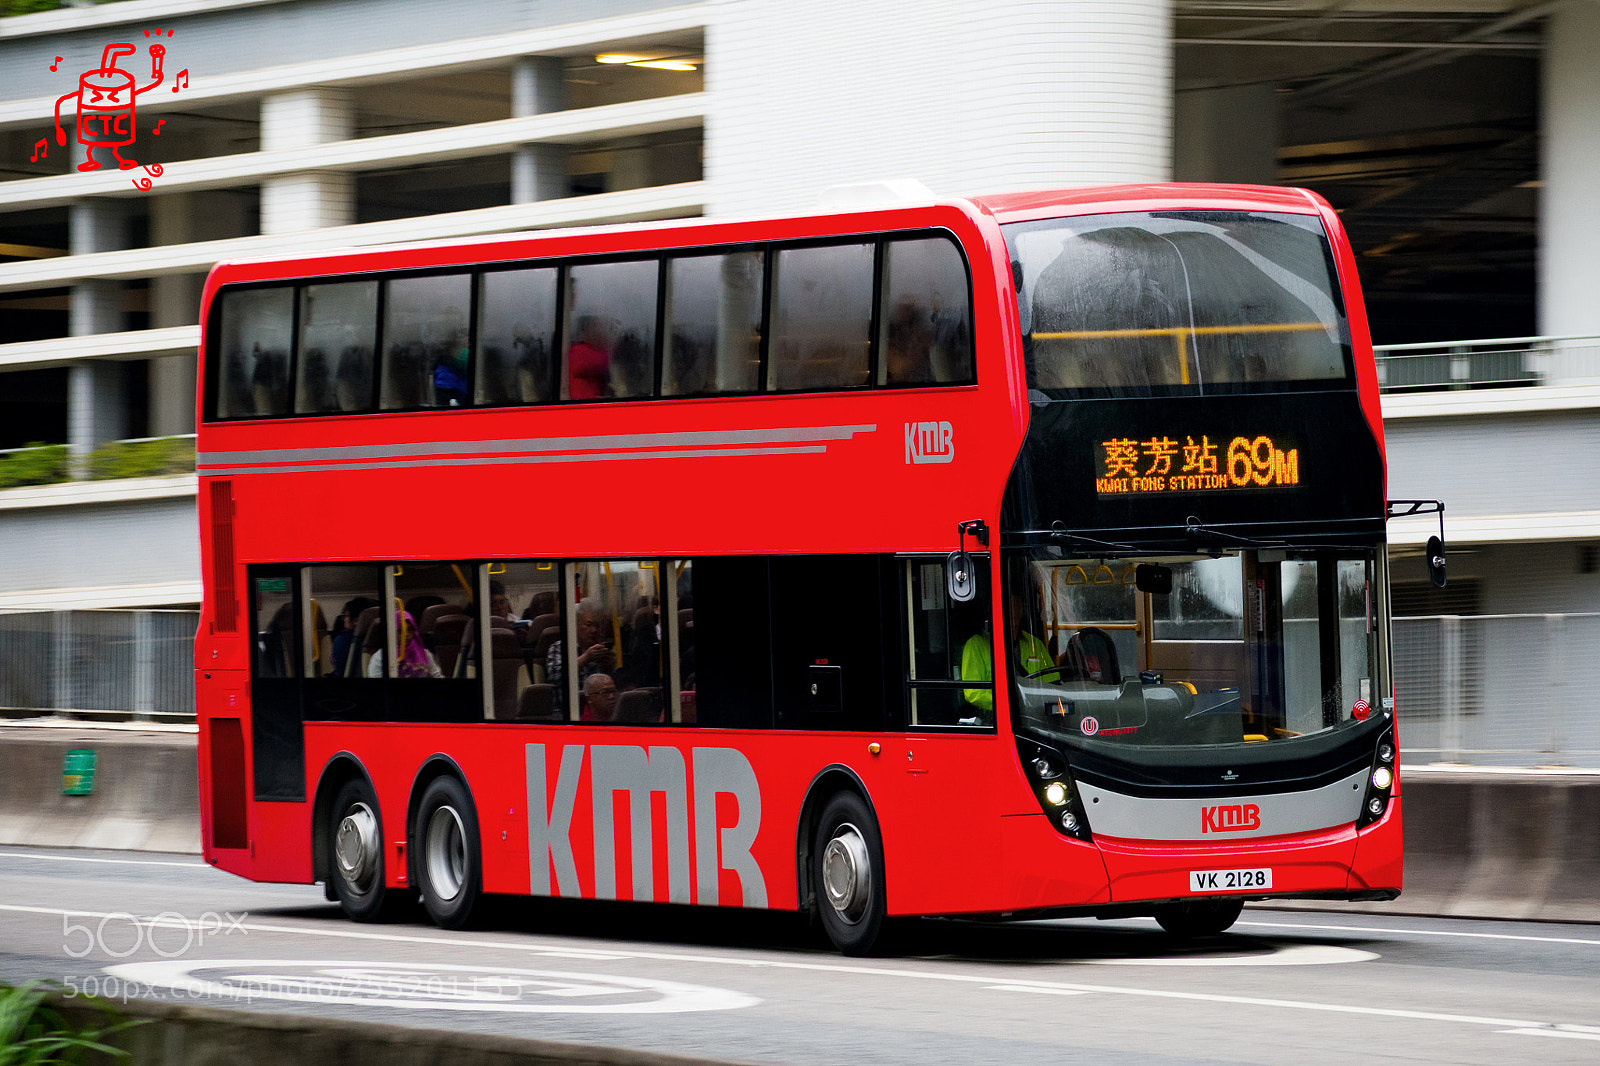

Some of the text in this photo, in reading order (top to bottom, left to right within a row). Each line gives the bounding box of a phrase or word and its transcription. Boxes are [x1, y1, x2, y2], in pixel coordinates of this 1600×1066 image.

[904, 421, 955, 465] KMB
[1101, 435, 1218, 477] 葵芳站
[1227, 436, 1299, 486] 69M
[1096, 474, 1228, 493] KWAI FONG STATION
[525, 743, 768, 909] KMB
[1201, 804, 1261, 834] KMB
[1196, 871, 1266, 888] VK 2128
